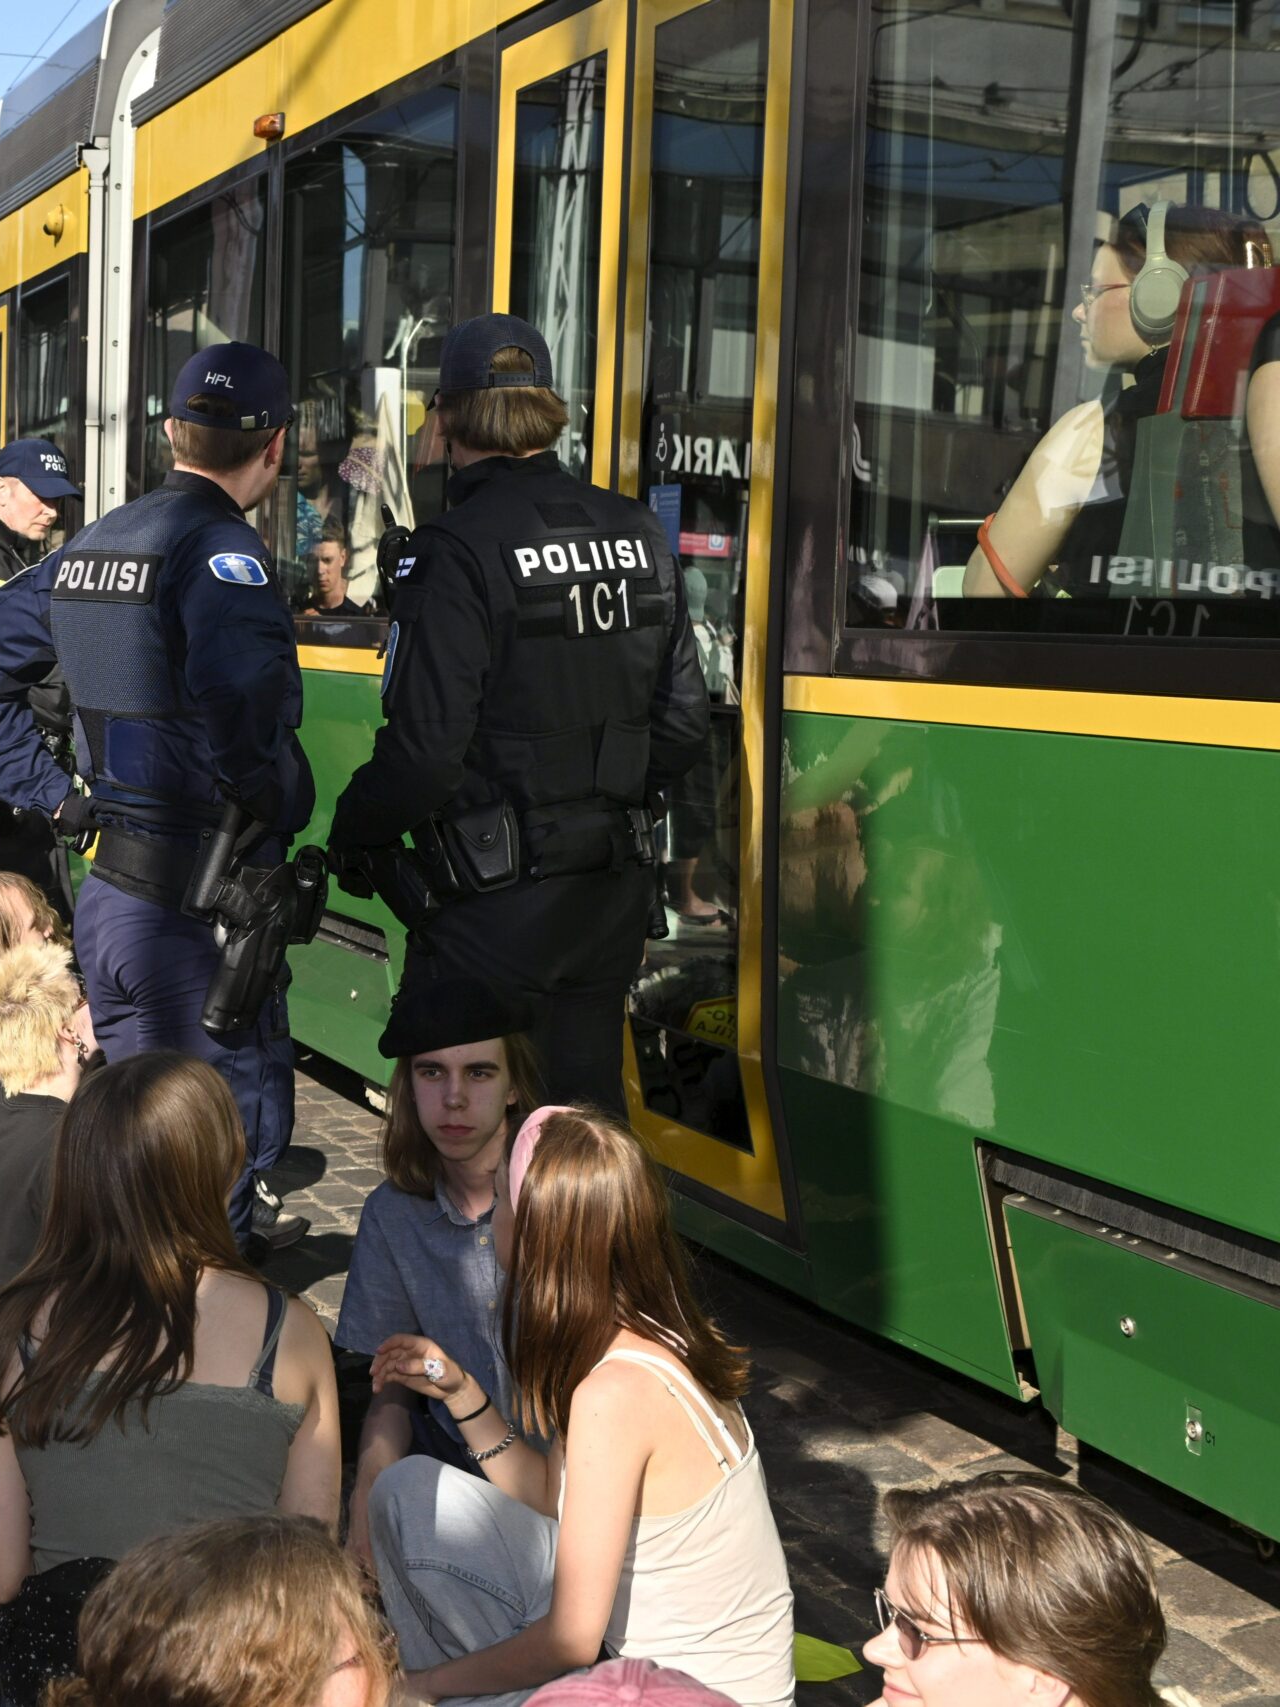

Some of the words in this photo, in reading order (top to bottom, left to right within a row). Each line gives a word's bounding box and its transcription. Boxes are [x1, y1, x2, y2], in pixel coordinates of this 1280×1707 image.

[205, 371, 234, 389] HPL
[514, 539, 648, 577] POLIISI
[54, 559, 150, 593] POLIISI
[569, 578, 630, 634] 1C1
[1205, 1431, 1216, 1447] C1
